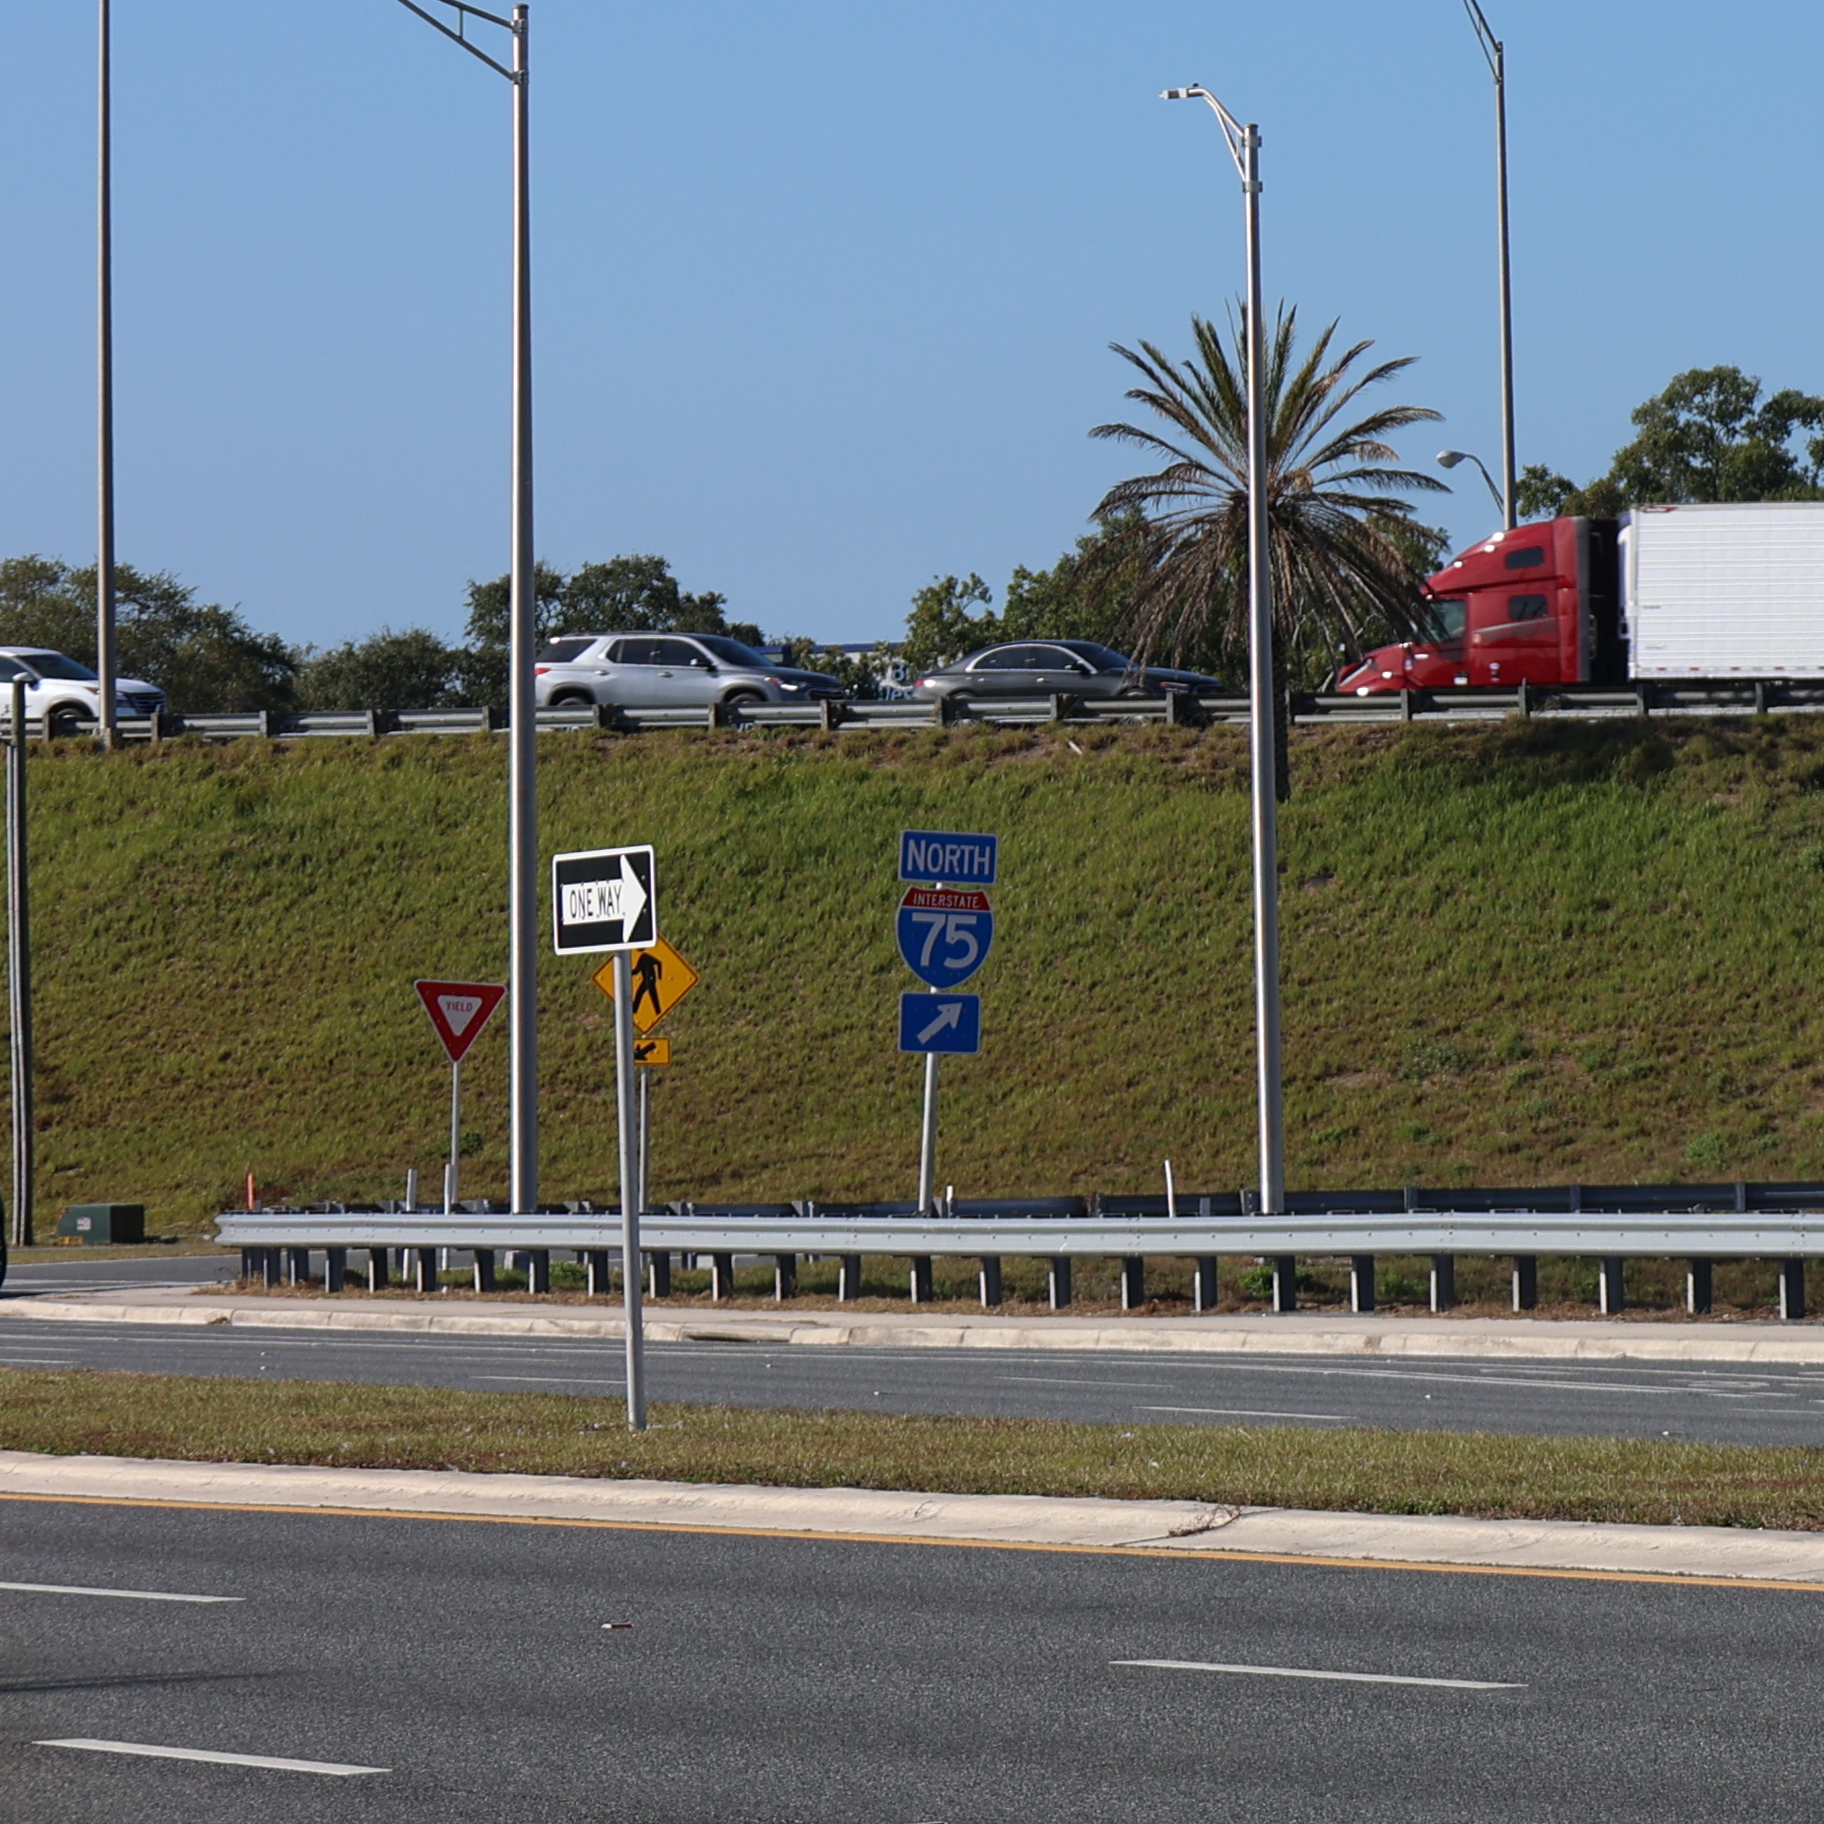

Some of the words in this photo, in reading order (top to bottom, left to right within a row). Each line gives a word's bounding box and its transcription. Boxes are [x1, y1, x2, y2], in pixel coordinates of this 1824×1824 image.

[906, 839, 991, 876] NORTH
[569, 887, 594, 919] ONE
[597, 885, 622, 916] WAY
[912, 893, 980, 909] INTERSTATE
[911, 911, 980, 969] 75
[446, 1001, 473, 1012] YIELD
